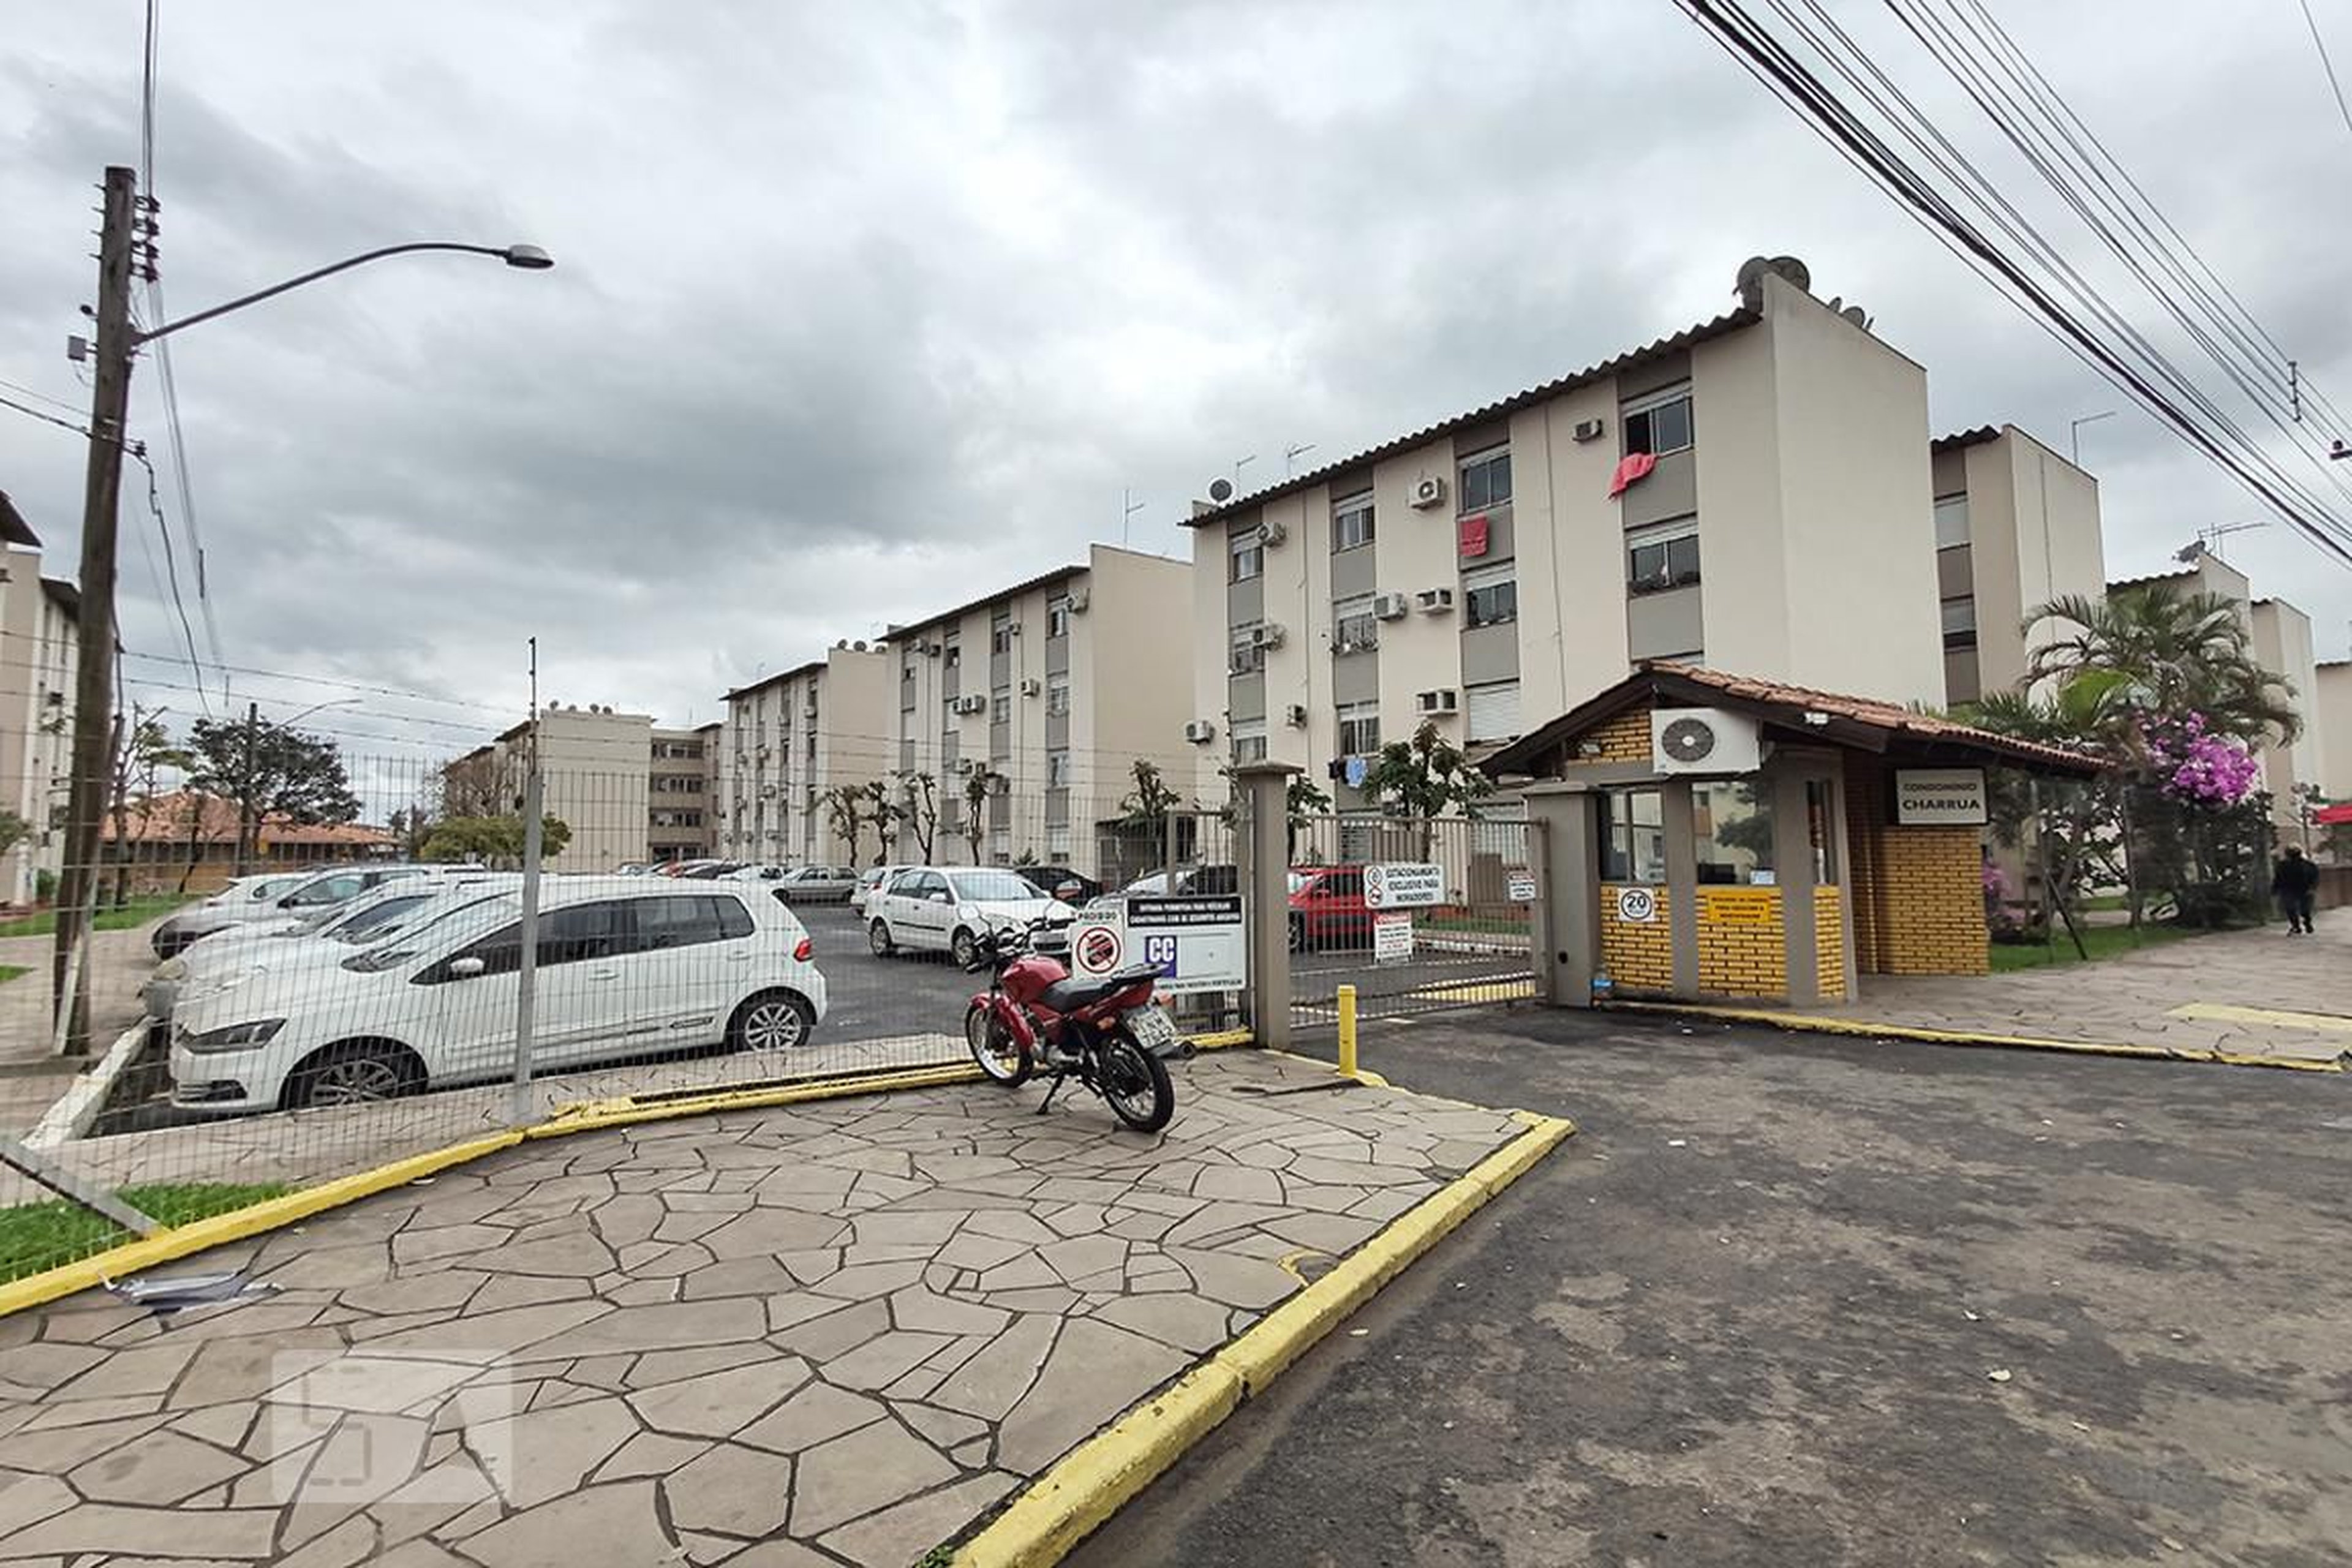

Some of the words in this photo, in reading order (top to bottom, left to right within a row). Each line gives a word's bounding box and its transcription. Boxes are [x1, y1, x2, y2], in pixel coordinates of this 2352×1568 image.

[1902, 799, 1980, 810] CHARRUA
[1627, 895, 1647, 909] 20
[1148, 937, 1175, 963] CC
